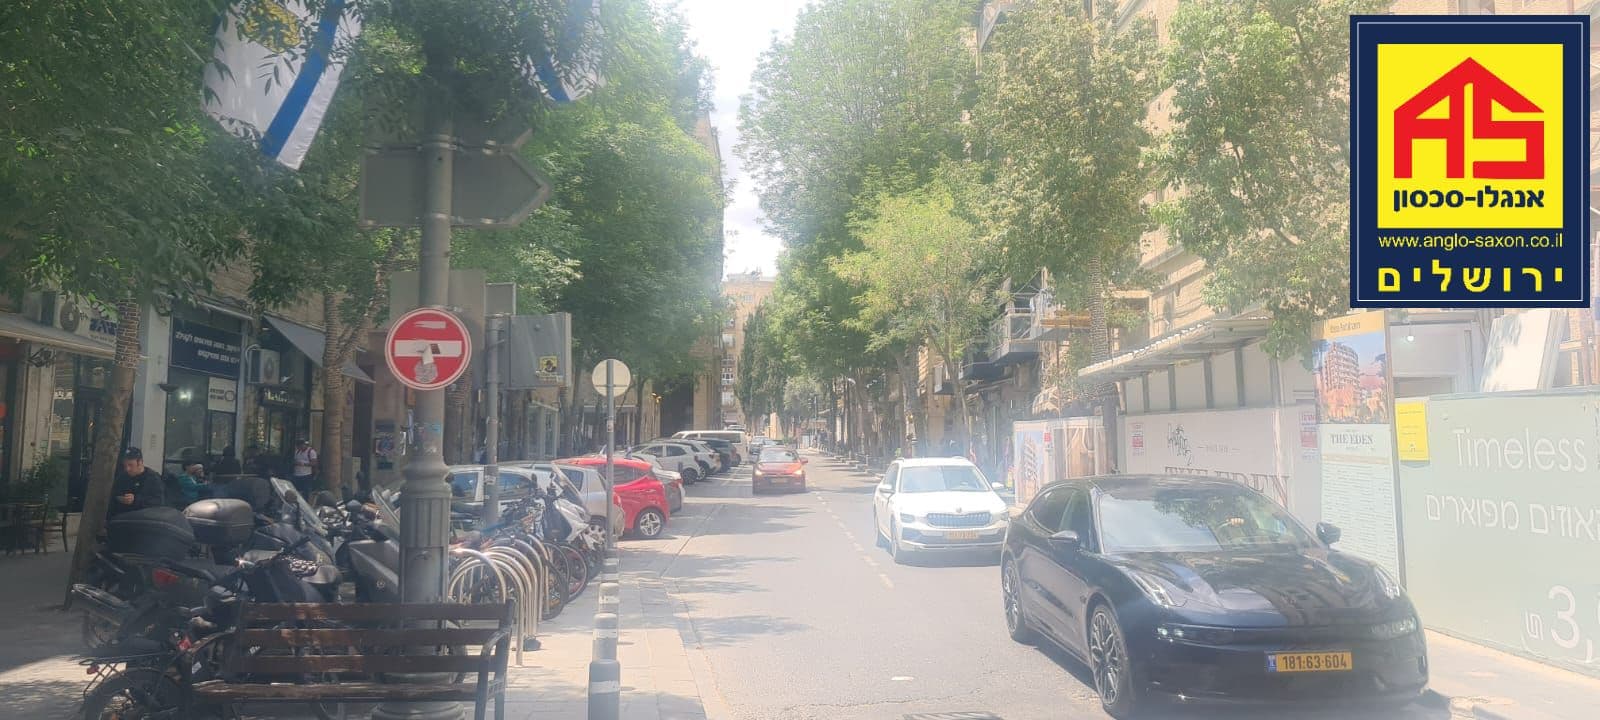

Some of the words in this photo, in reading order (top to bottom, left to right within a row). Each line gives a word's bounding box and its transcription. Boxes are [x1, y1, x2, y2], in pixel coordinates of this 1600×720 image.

[1330, 433, 1348, 444] THE
[1452, 427, 1587, 472] Timeless
[1426, 495, 1520, 530] מפוארים
